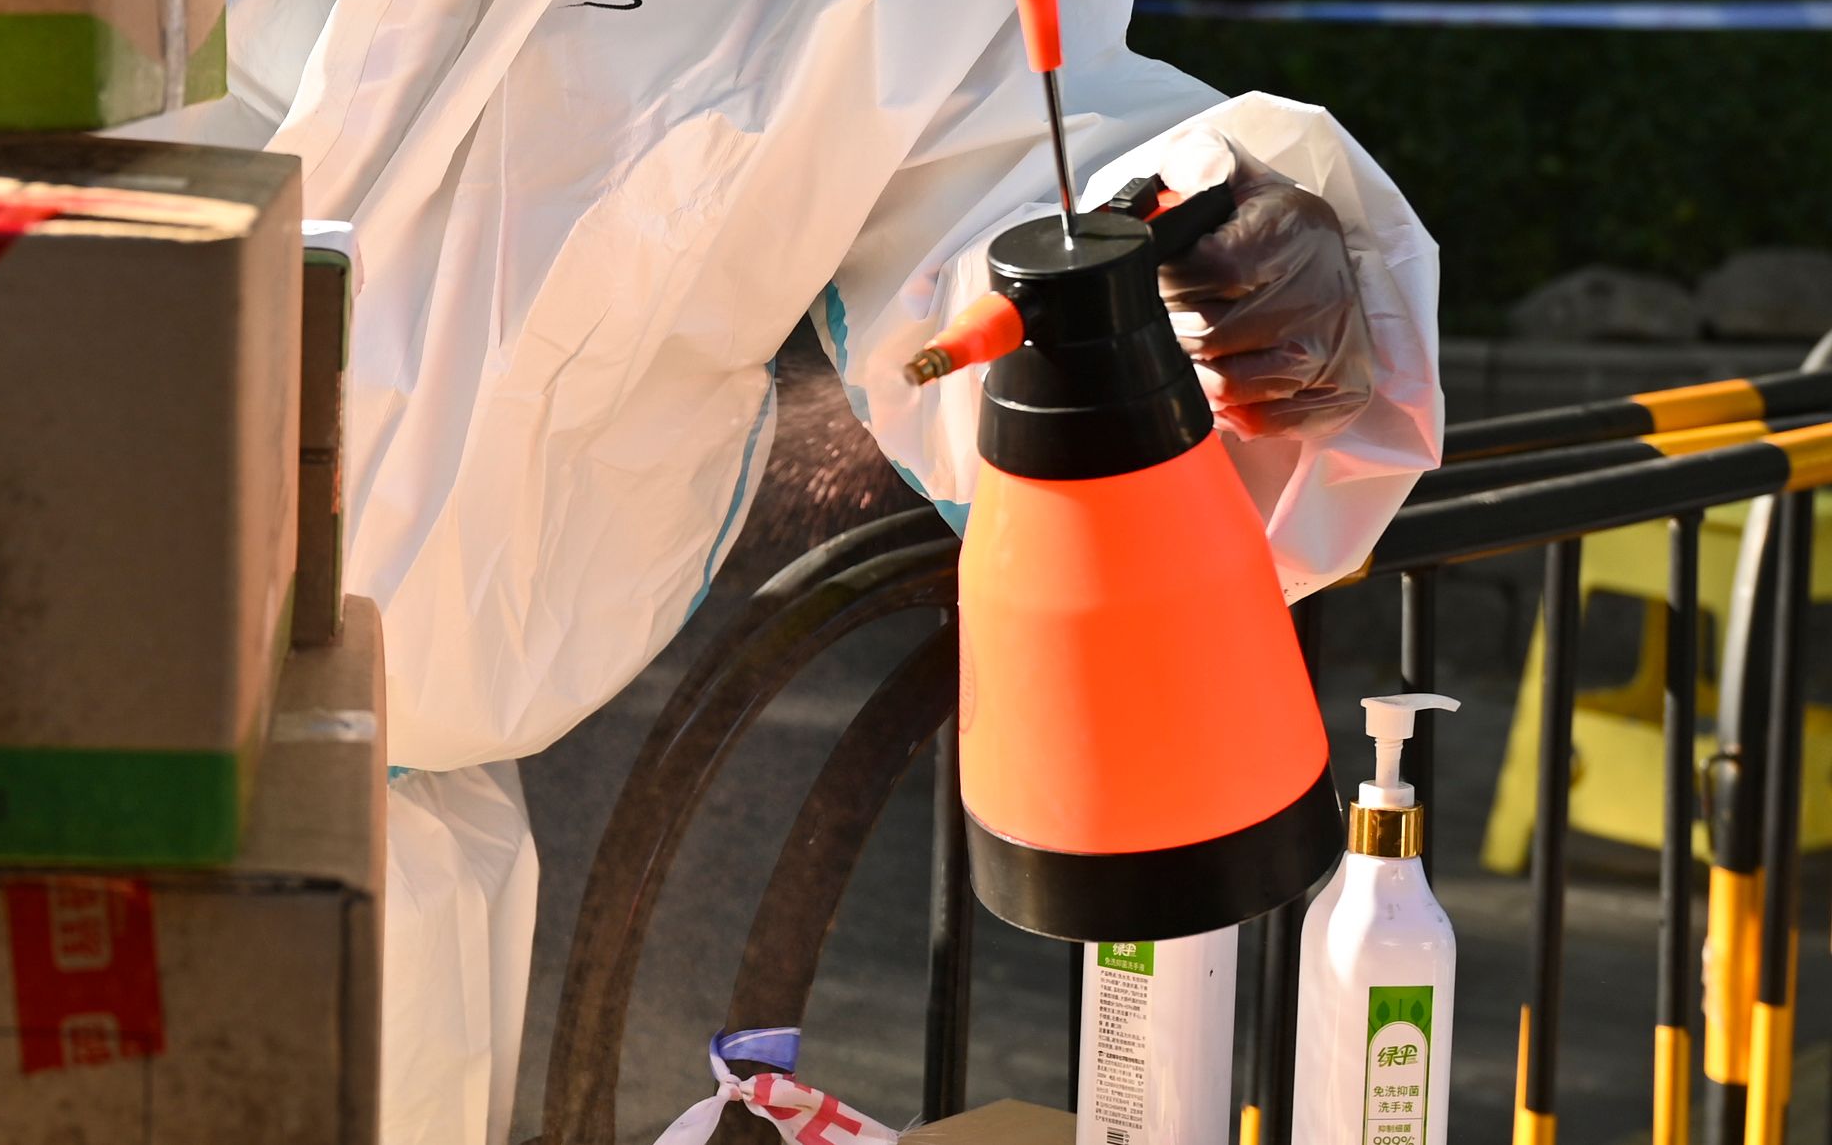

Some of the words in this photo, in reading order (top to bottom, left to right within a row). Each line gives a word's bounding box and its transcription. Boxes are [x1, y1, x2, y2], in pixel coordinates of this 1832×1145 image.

[1377, 1044, 1418, 1067] 绿伞
[1373, 1085, 1420, 1097] 免洗抑菌
[1378, 1101, 1414, 1113] 洗手液
[1378, 1124, 1411, 1133] 抑制细菌
